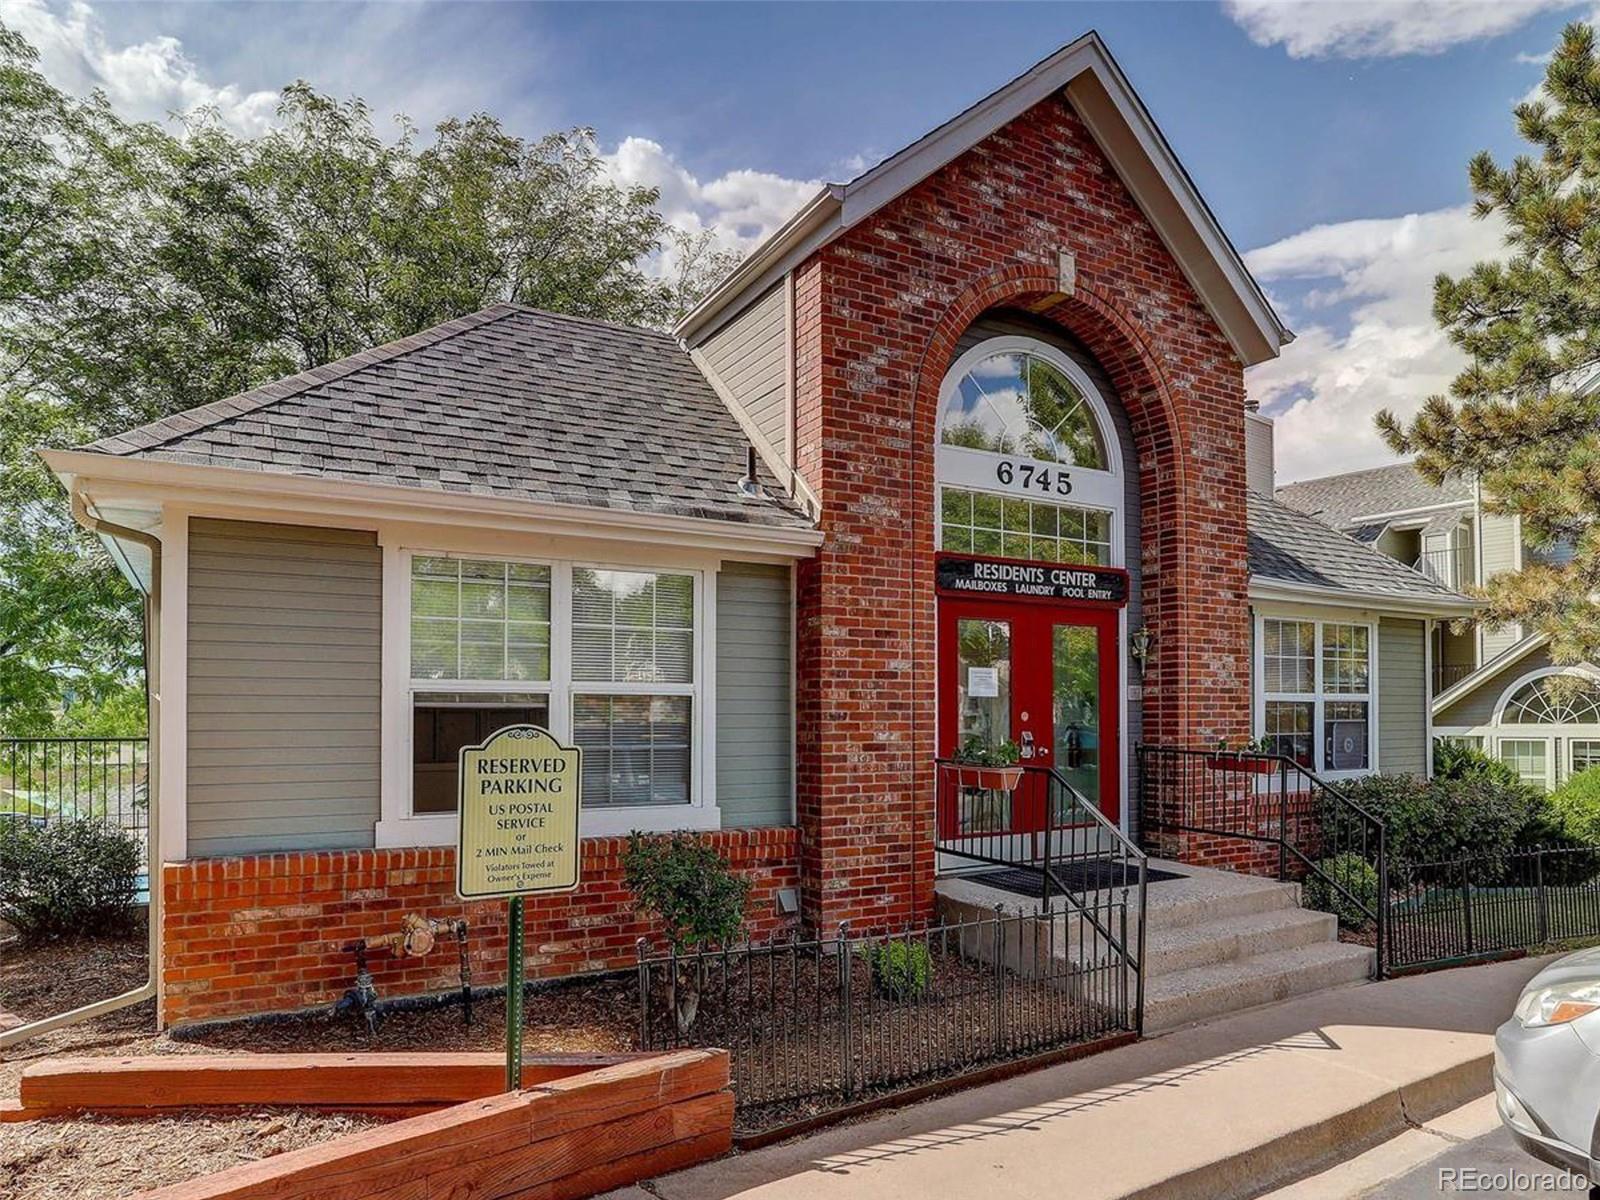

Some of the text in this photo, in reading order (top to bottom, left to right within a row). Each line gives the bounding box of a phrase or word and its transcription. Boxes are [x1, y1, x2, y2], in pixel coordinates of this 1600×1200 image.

[997, 461, 1072, 495] 6745
[974, 563, 1096, 587] RESIDENTS CENTER
[955, 579, 1112, 600] MAILBOXES LAUNDRY POOL ENTRY
[478, 758, 566, 774] RESERVED
[481, 778, 562, 795] PARKING
[489, 803, 553, 815] US POSTAL
[497, 818, 545, 830] SERVICE
[516, 832, 526, 841] or
[476, 843, 563, 858] 2 MIN Mail Check
[485, 863, 519, 872] Violators
[547, 860, 554, 868] at
[488, 872, 551, 883] Owner's Expense
